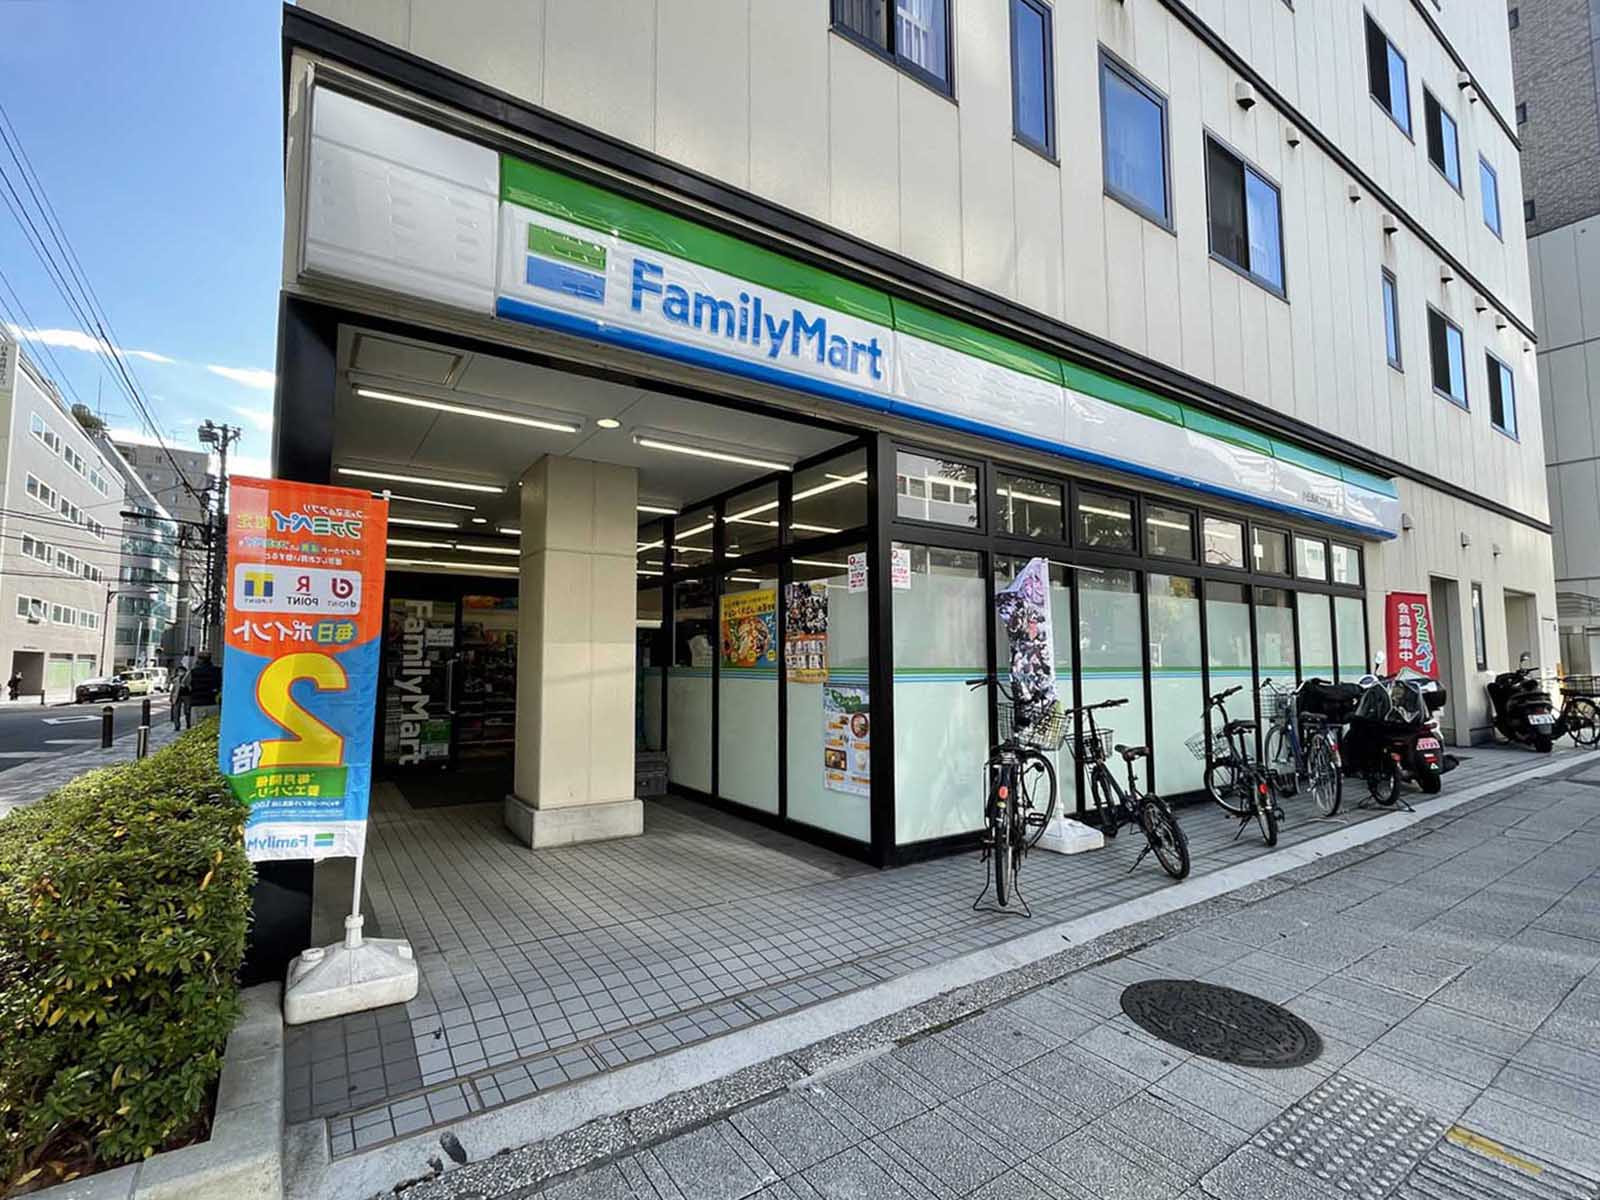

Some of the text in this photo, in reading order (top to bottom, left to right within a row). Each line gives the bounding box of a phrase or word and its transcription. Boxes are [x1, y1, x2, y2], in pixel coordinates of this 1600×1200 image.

[631, 258, 882, 379] FamilyMart
[393, 600, 433, 765] FamilyMart
[1410, 603, 1433, 672] ファミペイ
